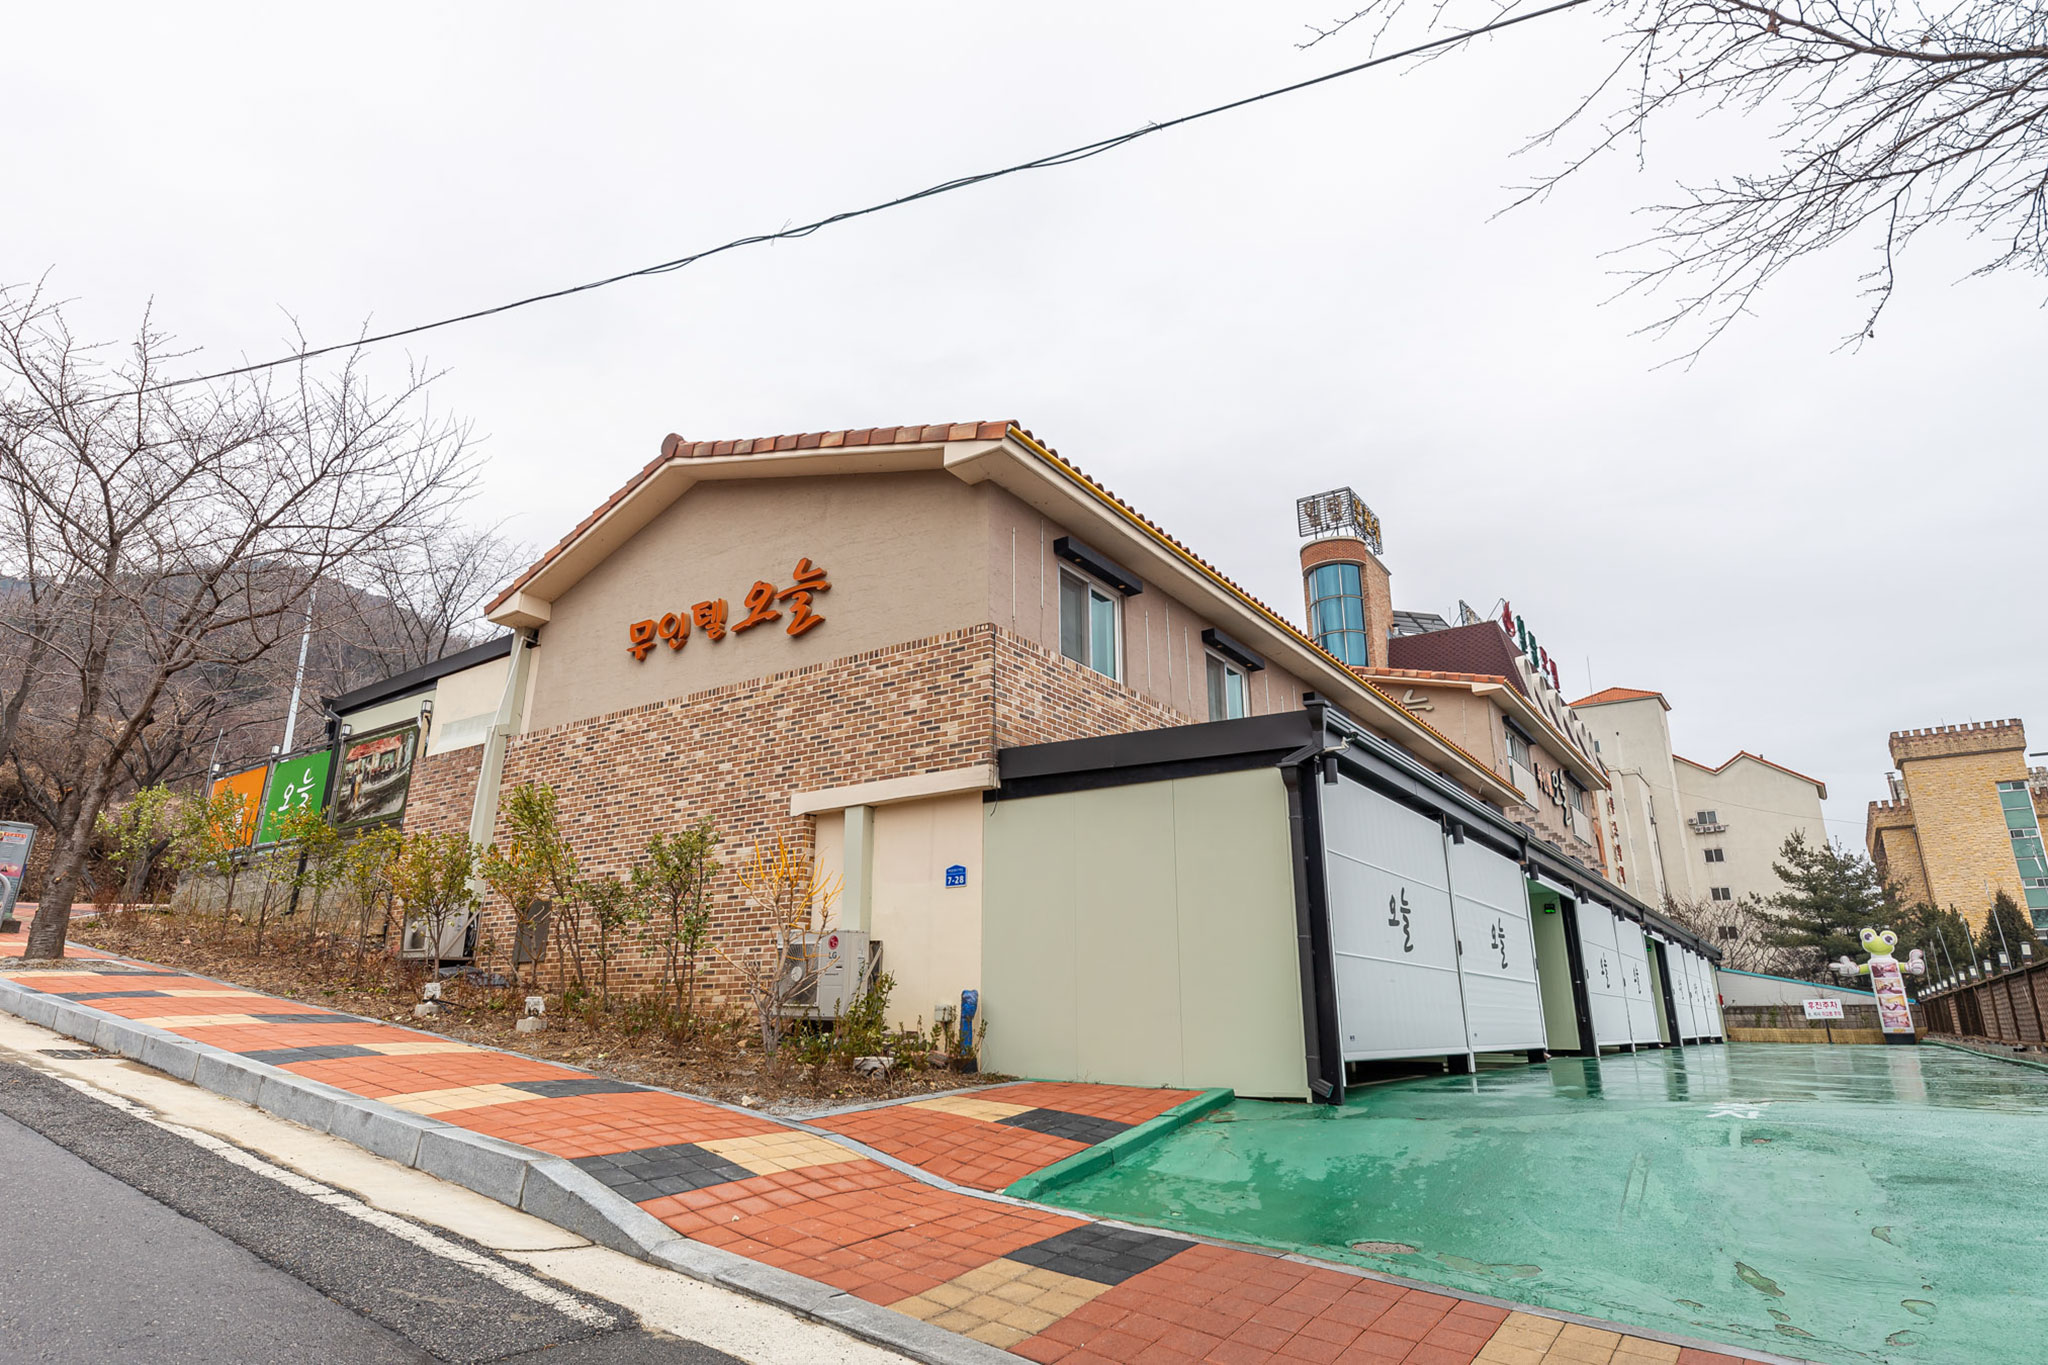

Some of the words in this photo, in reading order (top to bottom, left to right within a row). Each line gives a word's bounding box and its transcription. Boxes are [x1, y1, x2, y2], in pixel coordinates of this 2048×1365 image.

[627, 598, 728, 662] 무인텔
[731, 557, 832, 637] 오늘
[947, 875, 964, 885] 7-28
[1388, 887, 1414, 953] 오늘
[1491, 917, 1508, 969] 오늘
[828, 951, 838, 960] LG
